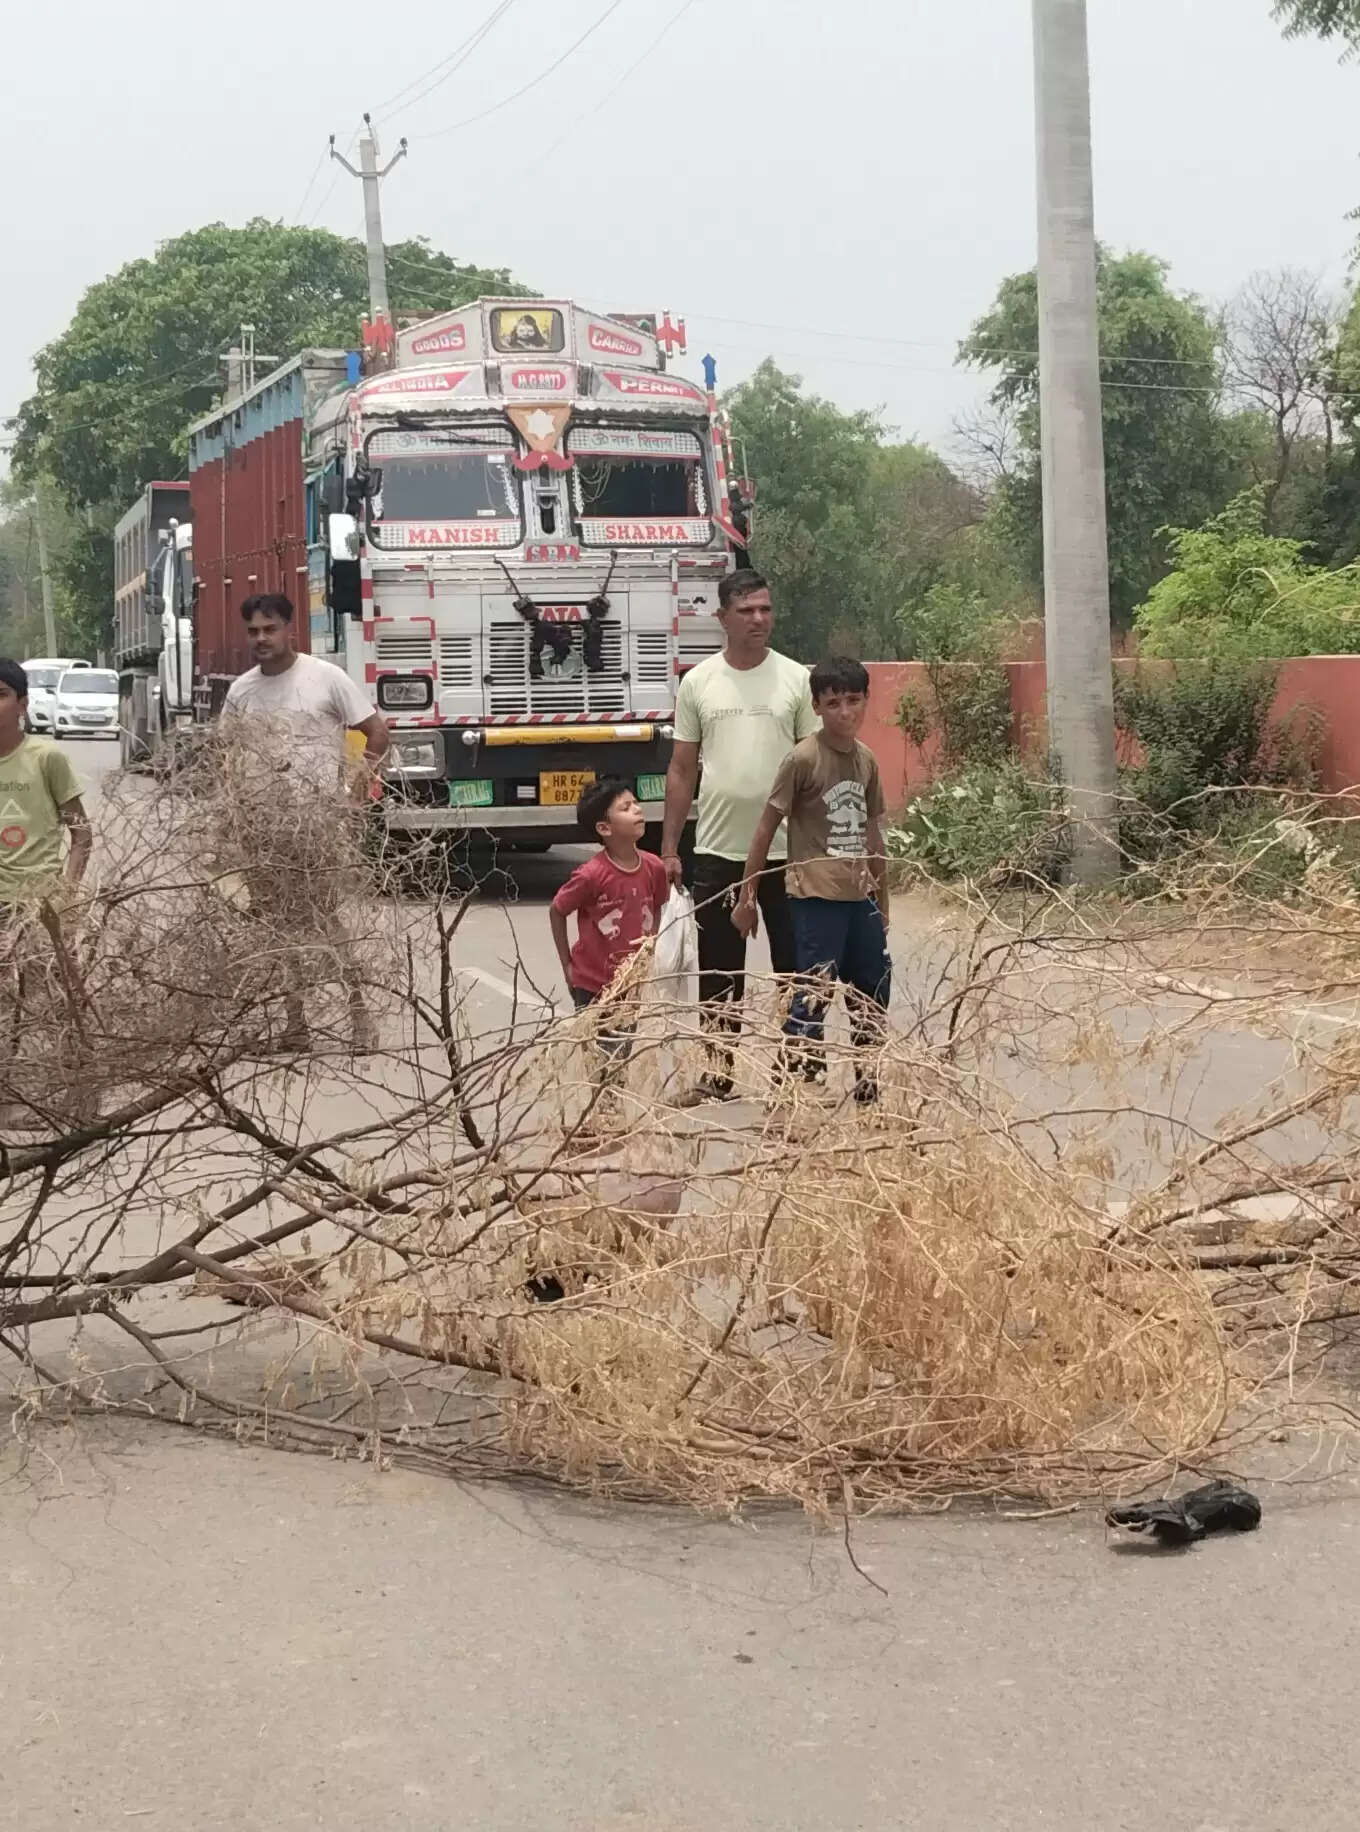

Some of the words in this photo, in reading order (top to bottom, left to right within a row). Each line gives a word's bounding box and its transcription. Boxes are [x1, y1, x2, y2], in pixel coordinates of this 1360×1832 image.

[414, 330, 464, 353] GOODS
[401, 374, 450, 392] INDIA
[620, 376, 684, 395] PERMIT
[407, 528, 500, 545] MANISH
[605, 525, 689, 541] SHARMA
[552, 774, 567, 787] HR
